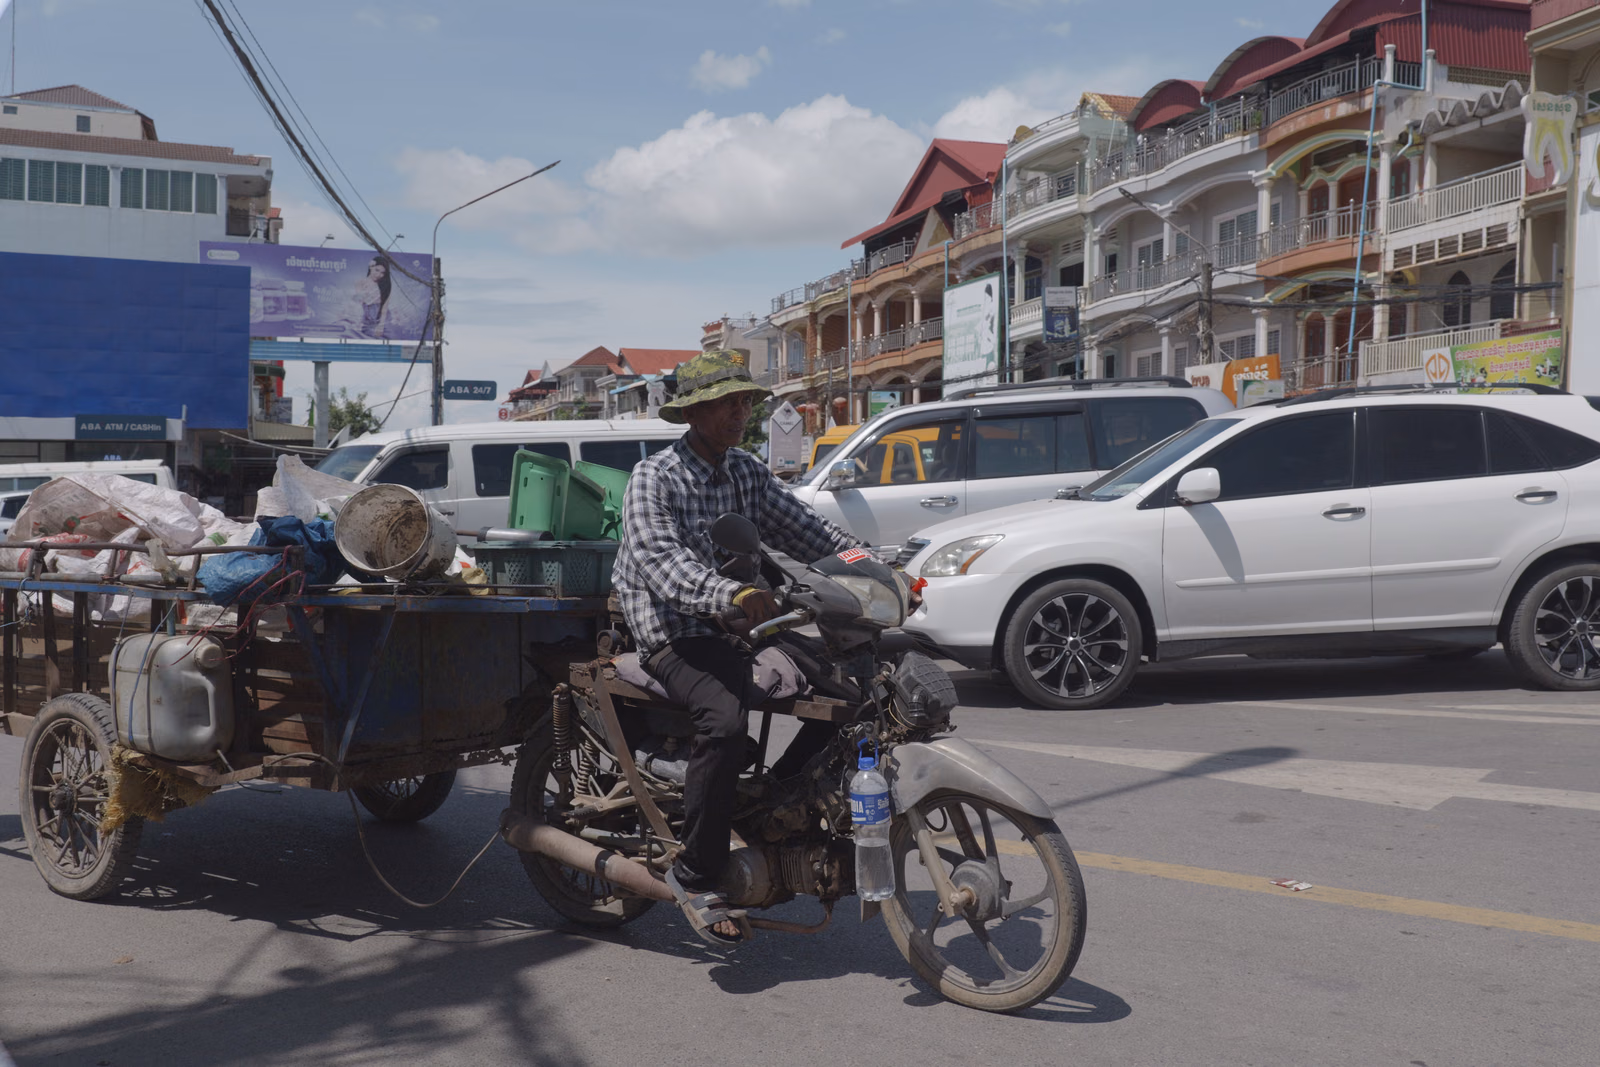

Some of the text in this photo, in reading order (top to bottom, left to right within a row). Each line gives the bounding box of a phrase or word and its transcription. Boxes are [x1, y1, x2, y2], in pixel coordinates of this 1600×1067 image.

[449, 386, 492, 395] ABA 24/7
[80, 423, 101, 431] ABA
[104, 423, 123, 431] ATM
